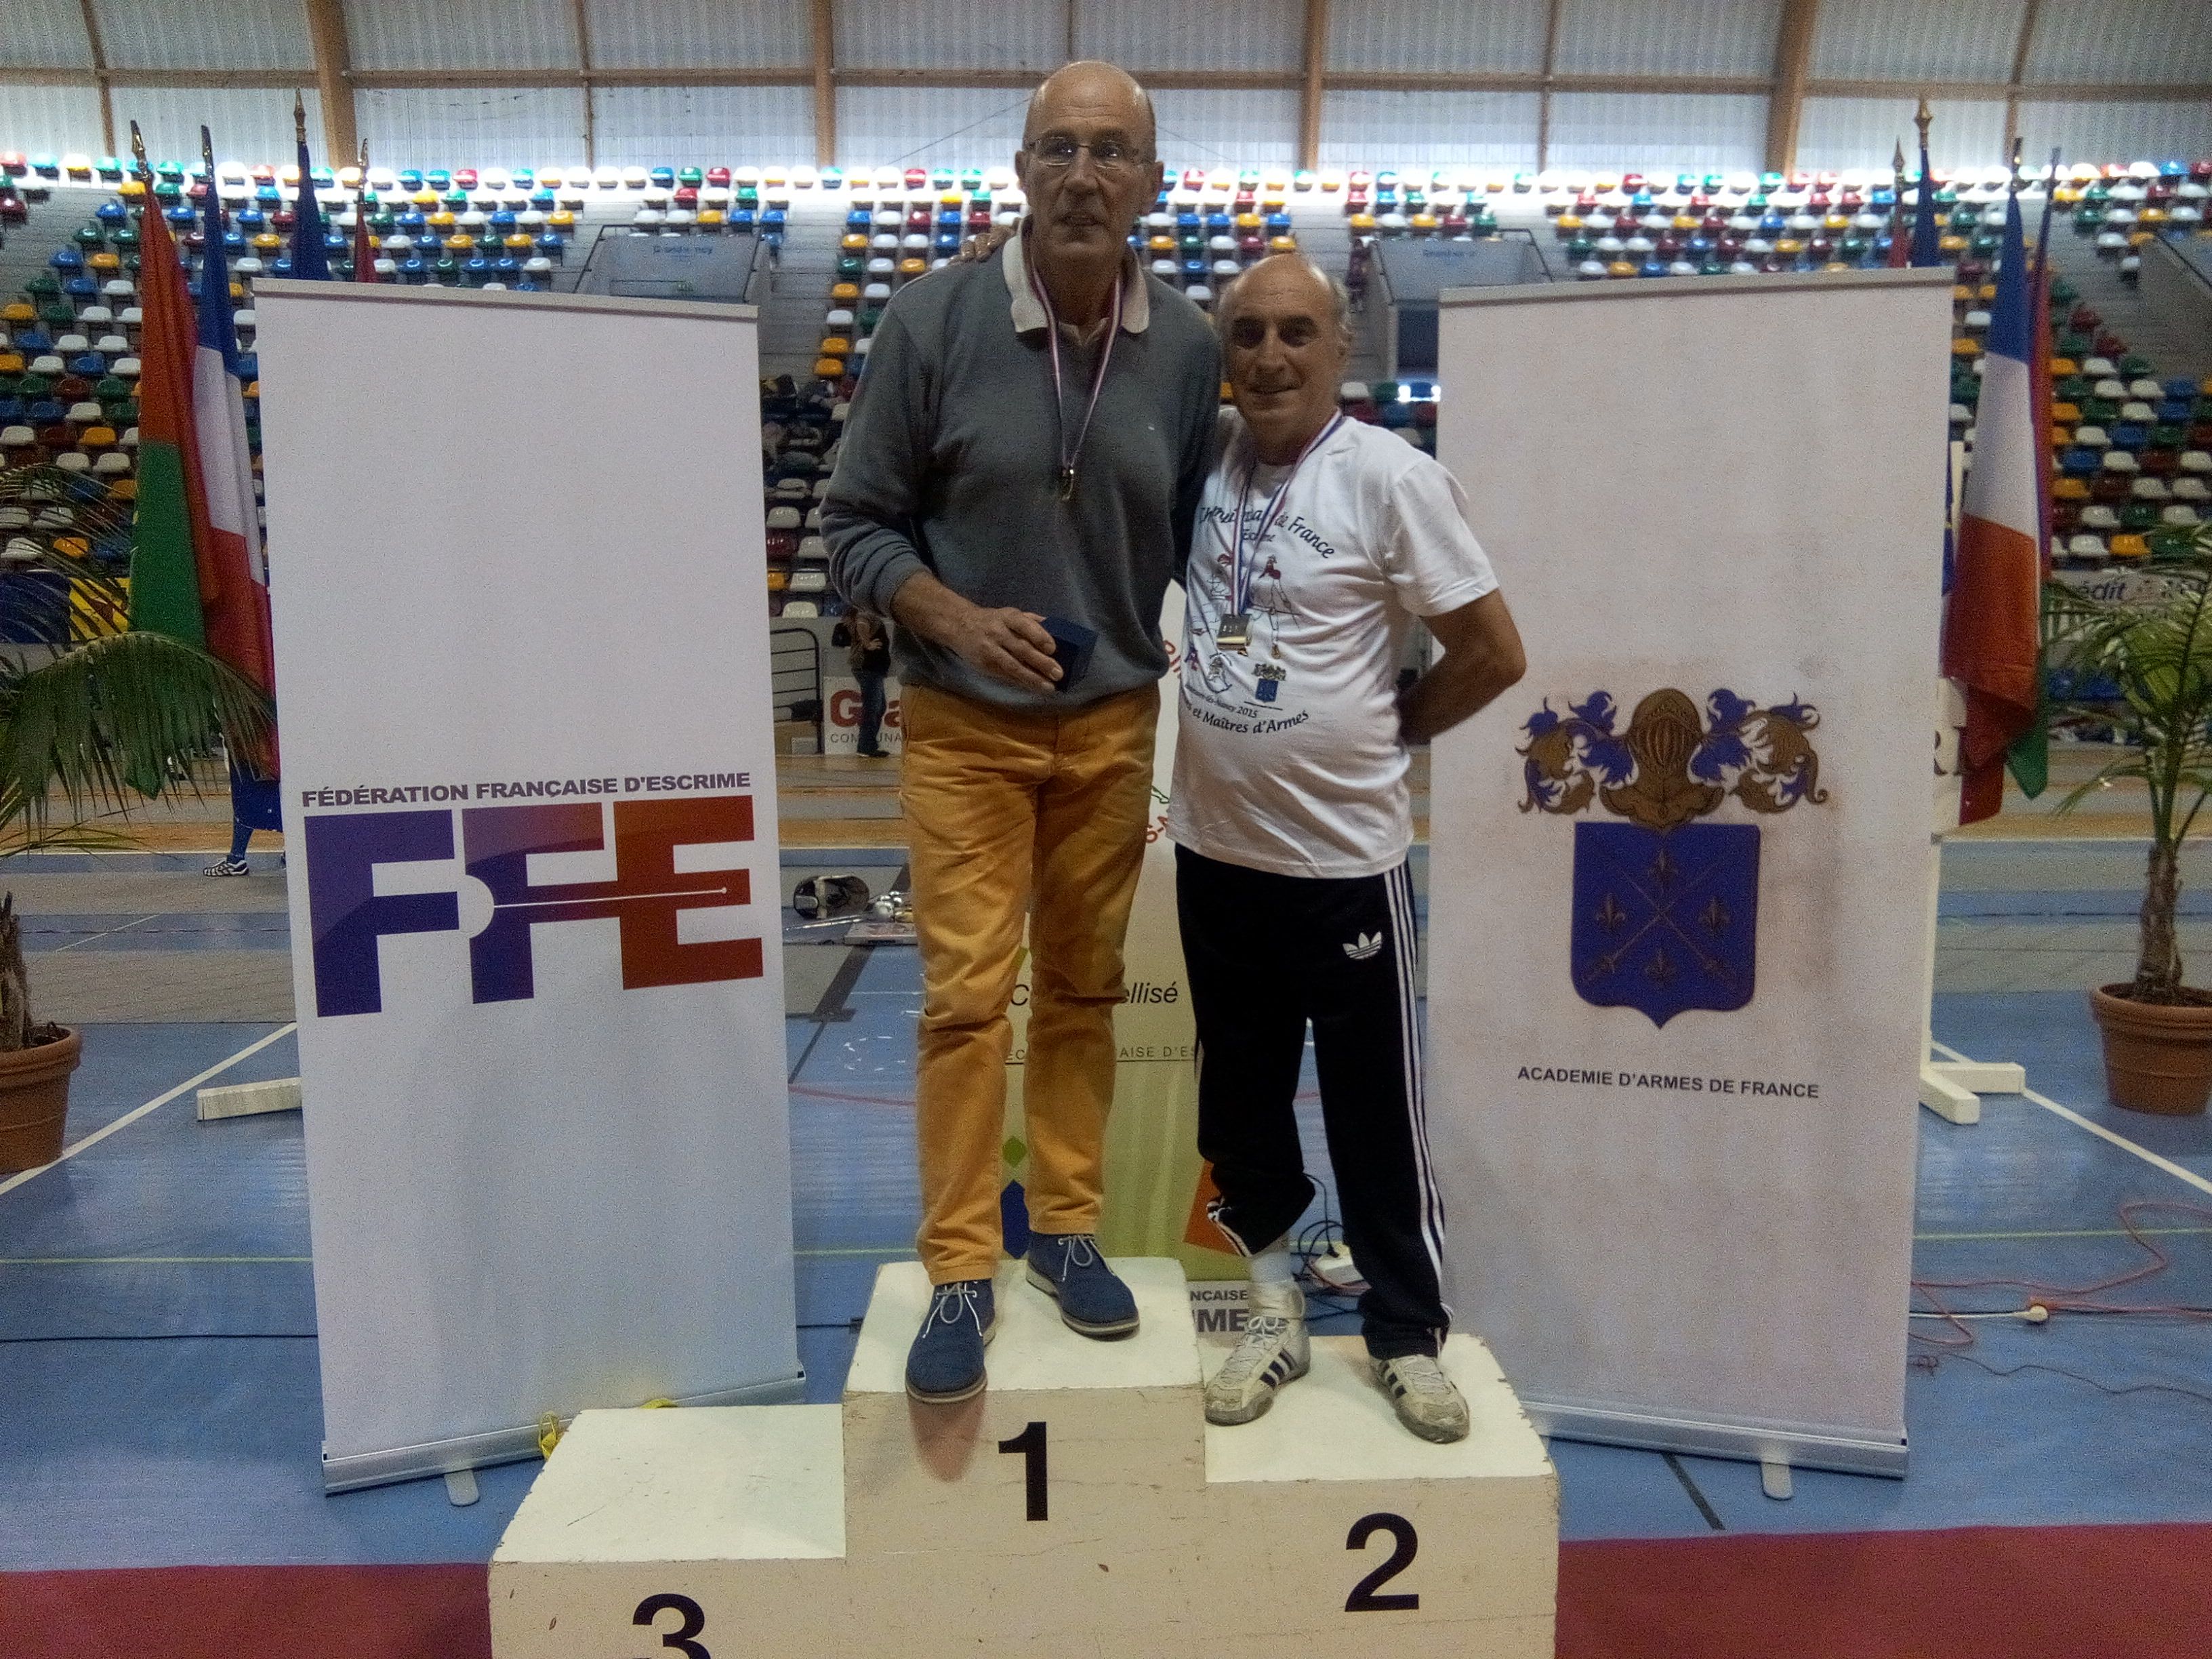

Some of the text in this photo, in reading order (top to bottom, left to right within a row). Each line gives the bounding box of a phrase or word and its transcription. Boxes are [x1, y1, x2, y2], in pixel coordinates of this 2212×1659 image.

[1288, 516, 1335, 559] France
[1193, 708, 1309, 734] et Maîtres d'Armes
[1236, 706, 1258, 719] 2015
[302, 771, 751, 808] FÉDÉRATION FRANÇAISE D'ESCRIME
[304, 794, 764, 1018] FFE
[1517, 1066, 1820, 1099] ACADEMIE D'ARMES DE FRANCE
[998, 1421, 1048, 1521] 1
[1345, 1513, 1419, 1612] 2
[633, 1593, 711, 1659] 3
